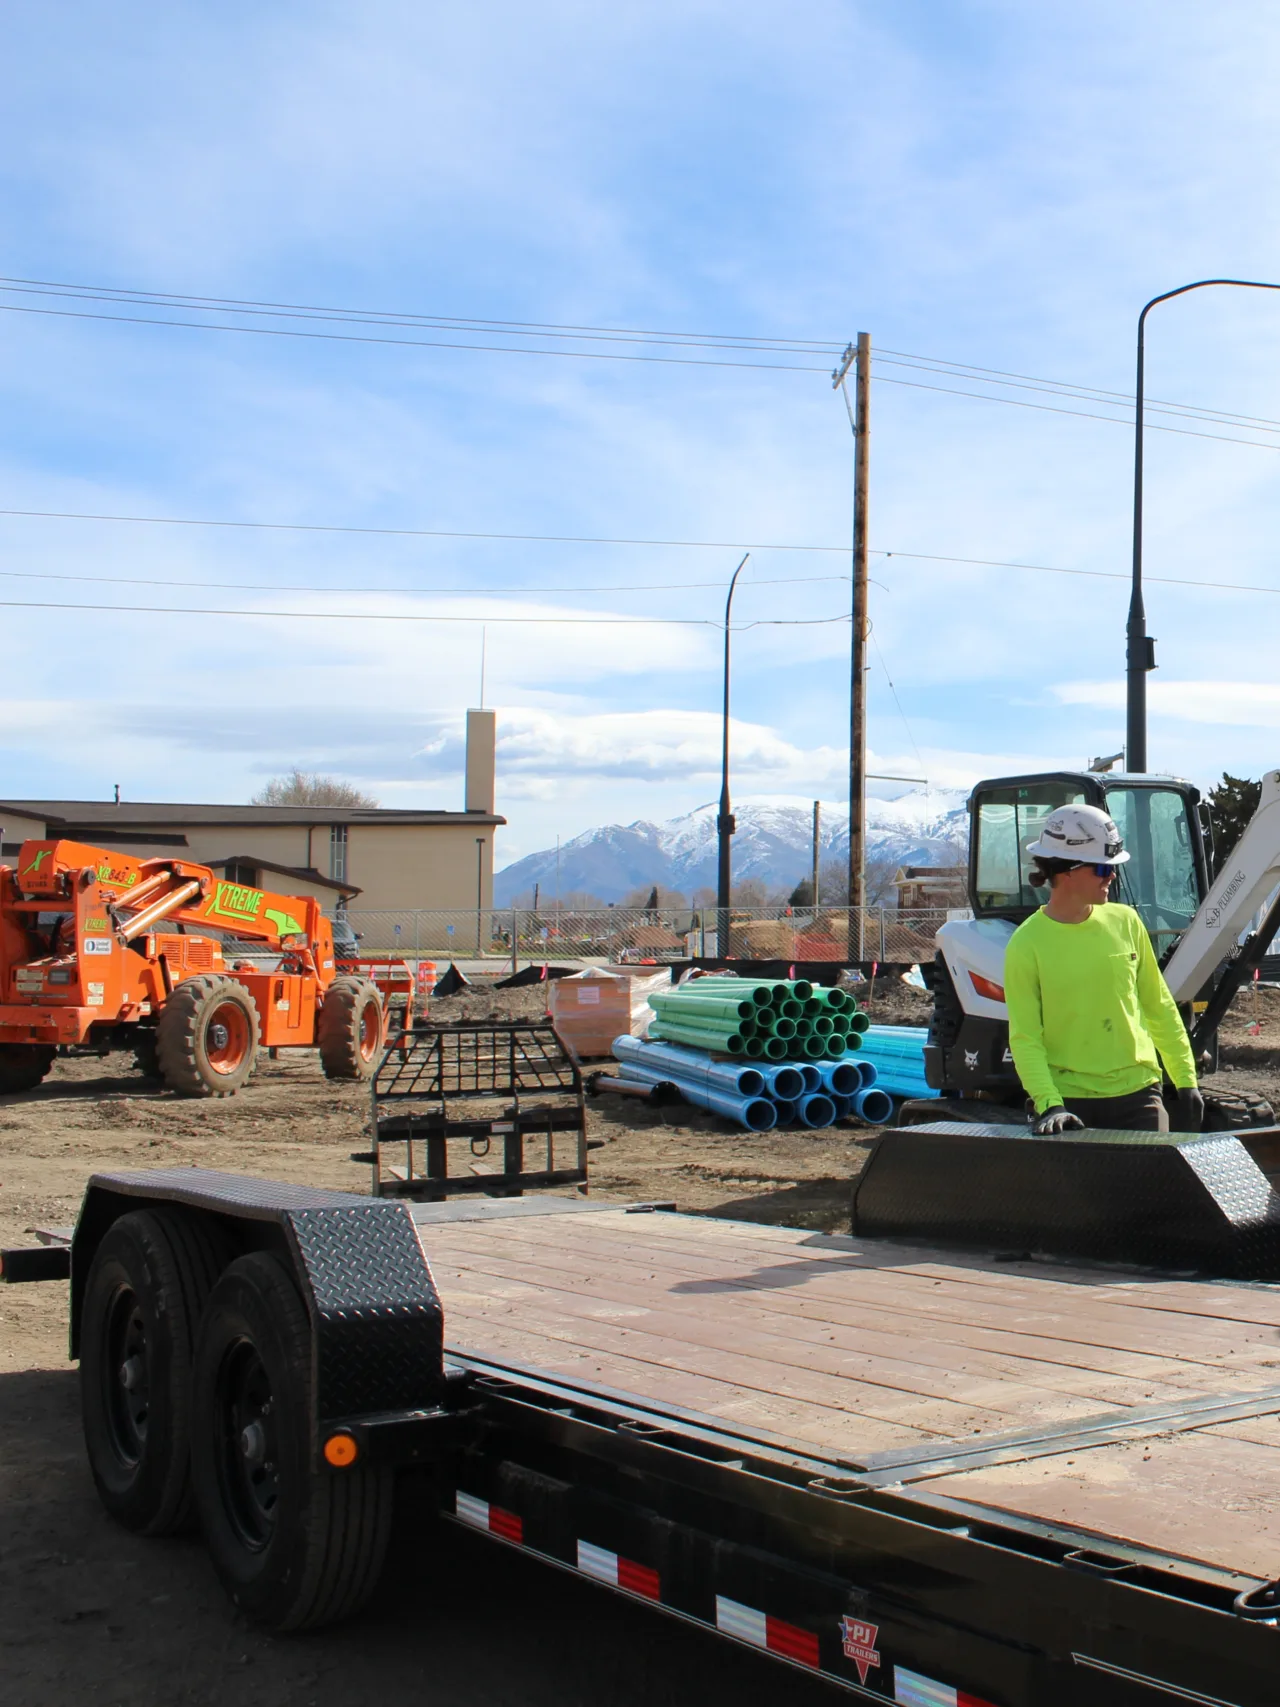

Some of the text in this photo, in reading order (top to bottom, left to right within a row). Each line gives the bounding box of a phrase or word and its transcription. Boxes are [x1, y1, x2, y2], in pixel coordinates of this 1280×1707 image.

[204, 882, 264, 920] XTREME
[1206, 869, 1246, 928] S&B PLUMBING
[83, 918, 107, 931] XTREME
[853, 1625, 870, 1644] PJ
[846, 1644, 878, 1662] TRAILERS
